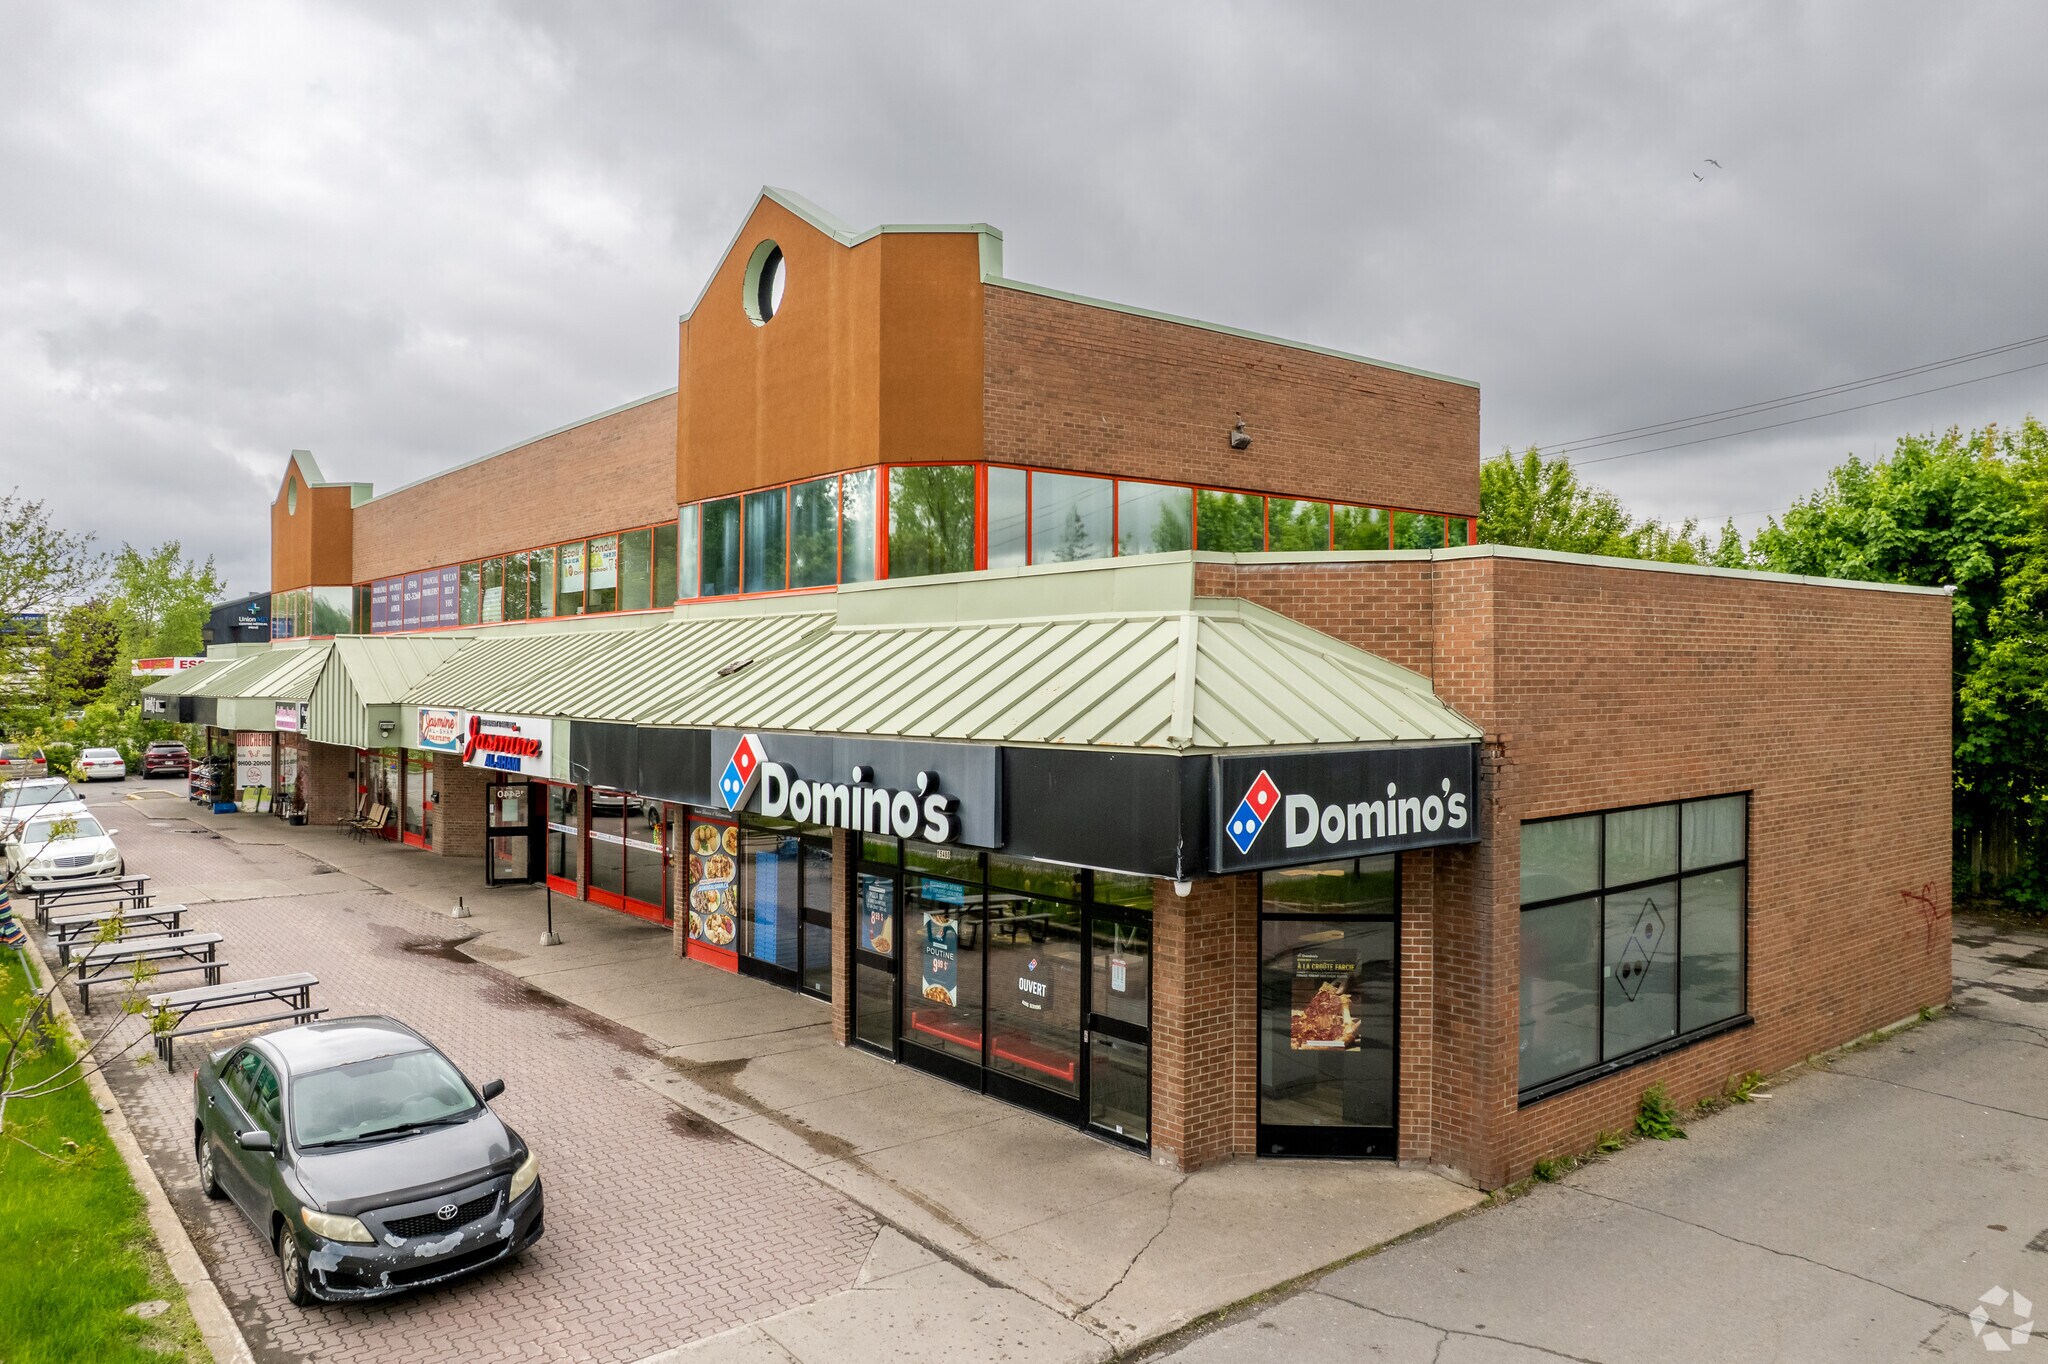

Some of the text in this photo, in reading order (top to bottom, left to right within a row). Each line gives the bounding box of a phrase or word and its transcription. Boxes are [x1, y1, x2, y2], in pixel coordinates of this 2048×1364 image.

[590, 541, 616, 554] Conduit
[444, 586, 455, 595] HELP
[445, 599, 453, 607] YOU
[424, 711, 455, 741] Jasmine
[237, 733, 271, 747] BOUCHERIE
[463, 715, 542, 763] Jasmine
[484, 753, 521, 772] AL-SHAM
[761, 761, 952, 844] Domino's
[1286, 777, 1467, 848] Domino's
[926, 946, 954, 961] POUTINE
[1019, 977, 1047, 998] OUVERT
